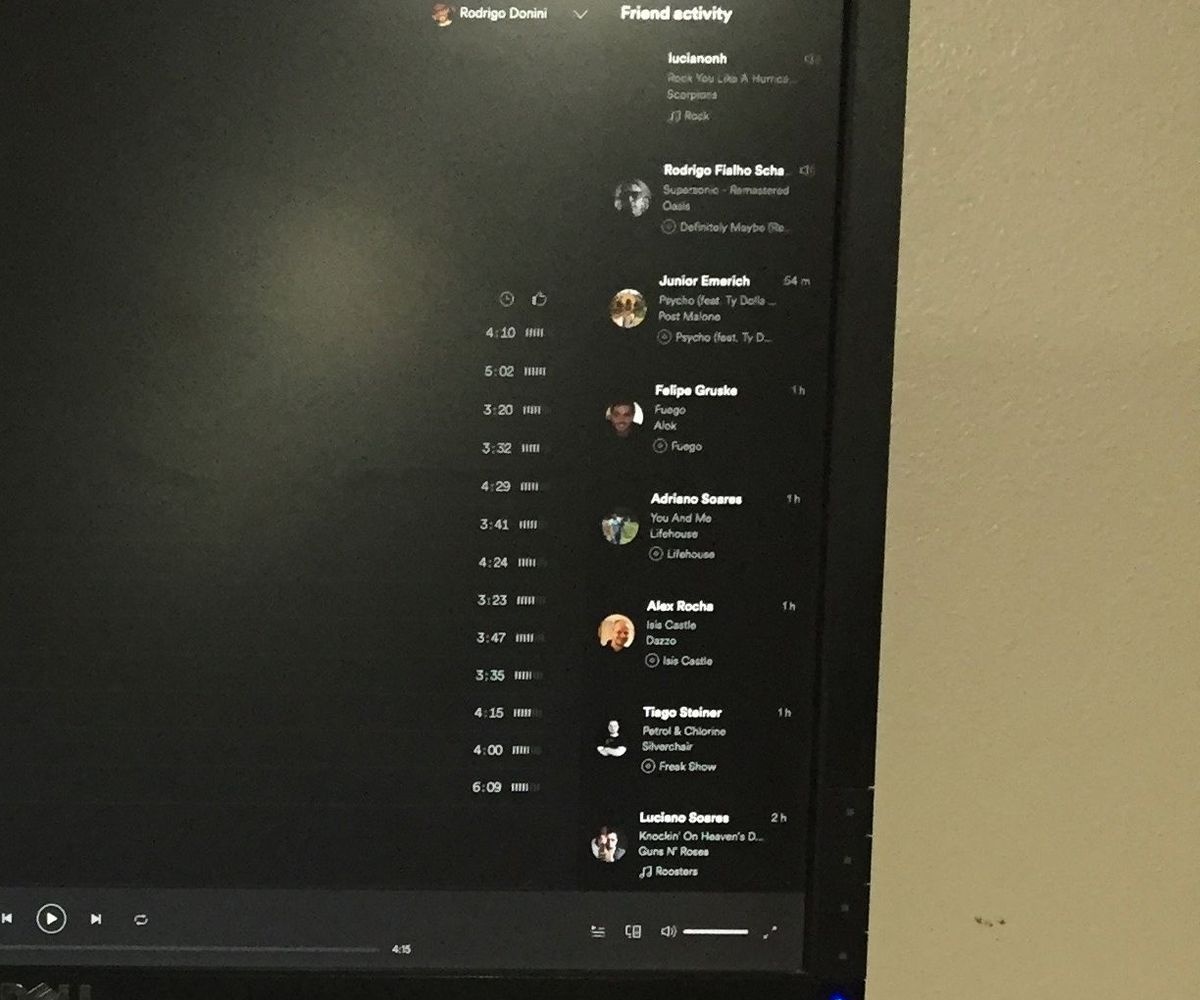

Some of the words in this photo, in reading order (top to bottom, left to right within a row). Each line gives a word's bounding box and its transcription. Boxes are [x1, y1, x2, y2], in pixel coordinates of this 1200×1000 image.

[459, 6, 507, 22] Rodrigo
[509, 6, 548, 19] Donini
[620, 4, 671, 21] Friend
[672, 5, 733, 24] activity
[485, 326, 517, 339] 4:10
[484, 365, 515, 378] 5:02
[482, 403, 514, 416] 3:20
[481, 442, 512, 455] 3:32
[480, 480, 512, 493] 4:29
[479, 518, 509, 530] 3:41
[478, 556, 508, 568] 4:24
[477, 594, 508, 606] 3:23
[646, 599, 675, 612] Alex
[676, 599, 714, 612] Rocha
[476, 631, 507, 644] 3:47
[475, 669, 506, 682] 3:35
[474, 707, 504, 719] 4:15
[642, 706, 678, 721] Tiago
[679, 705, 723, 719] Steiner
[473, 744, 504, 756] 4:00
[658, 760, 687, 772] Freak
[688, 761, 717, 772] Show
[472, 781, 503, 793] 6:09
[639, 811, 687, 824] Luciano
[688, 811, 730, 824] Soares
[655, 865, 699, 877] Roosters
